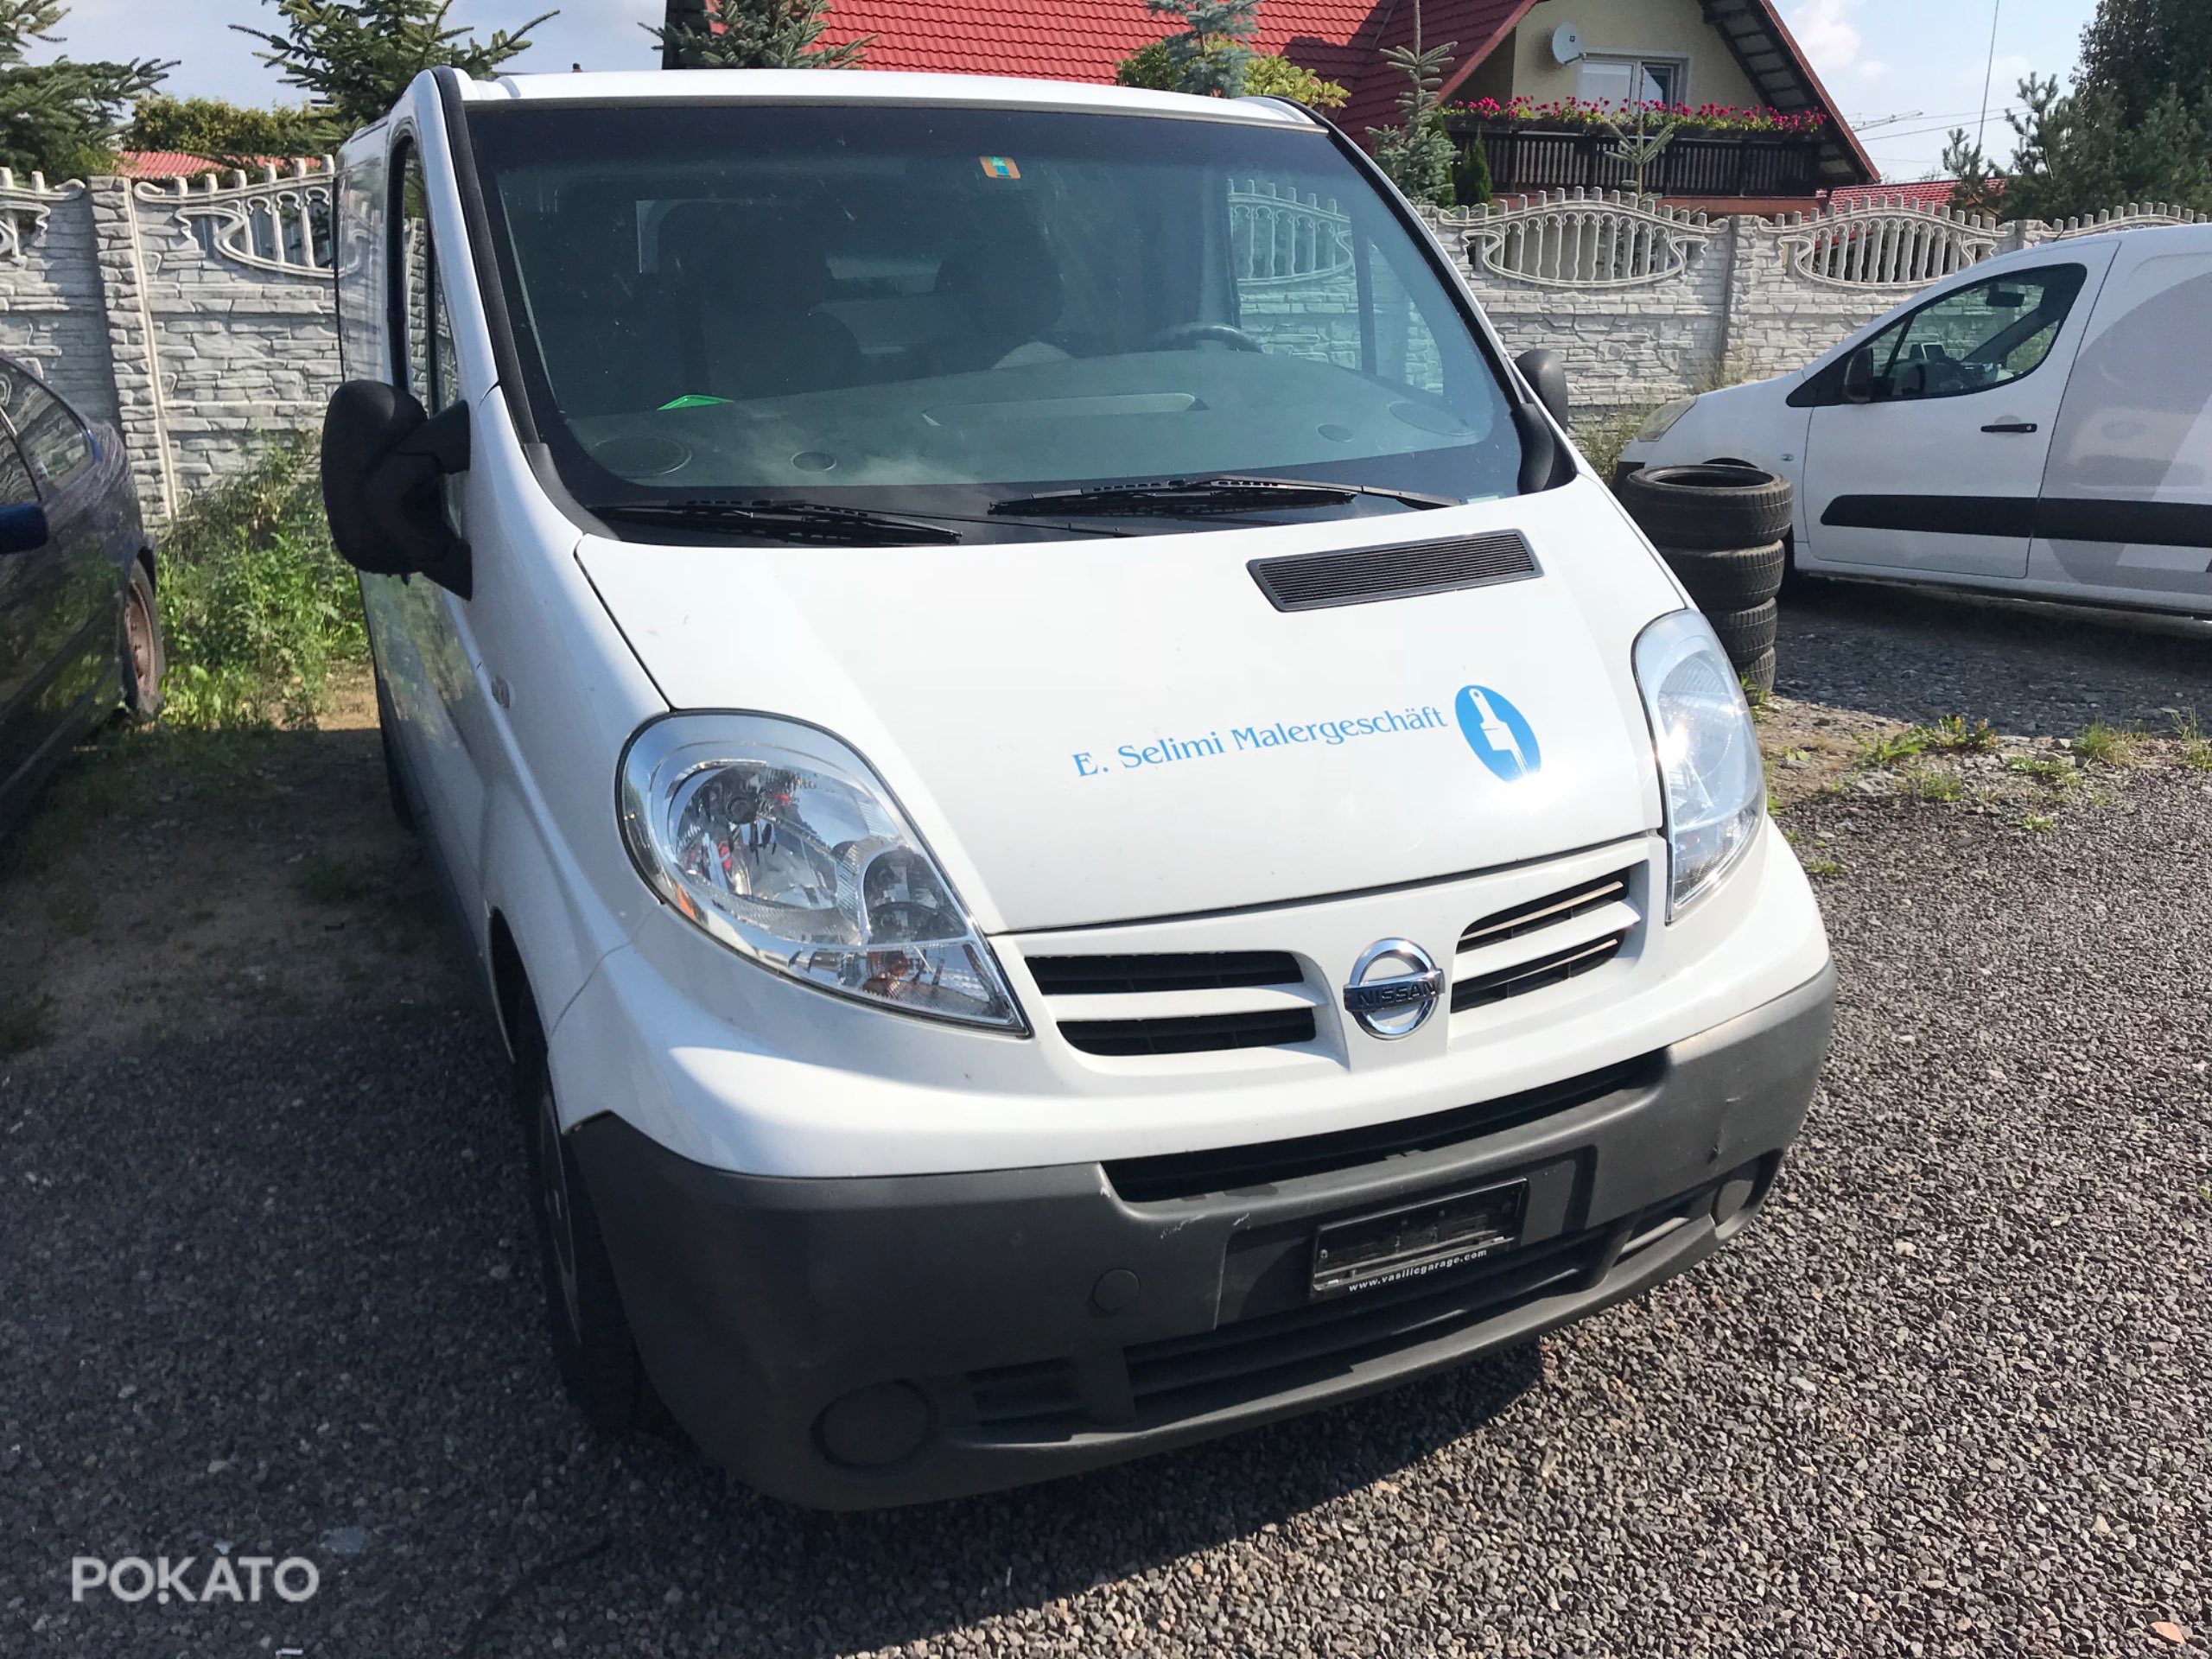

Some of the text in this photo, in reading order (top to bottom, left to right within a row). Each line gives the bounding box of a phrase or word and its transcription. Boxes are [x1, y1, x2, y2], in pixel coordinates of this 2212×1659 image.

[1072, 705, 1449, 777] E. Selimi Malergeschäft
[1358, 979, 1436, 1008] NISSAN
[1349, 1249, 1487, 1292] www.vasilicgarage.com
